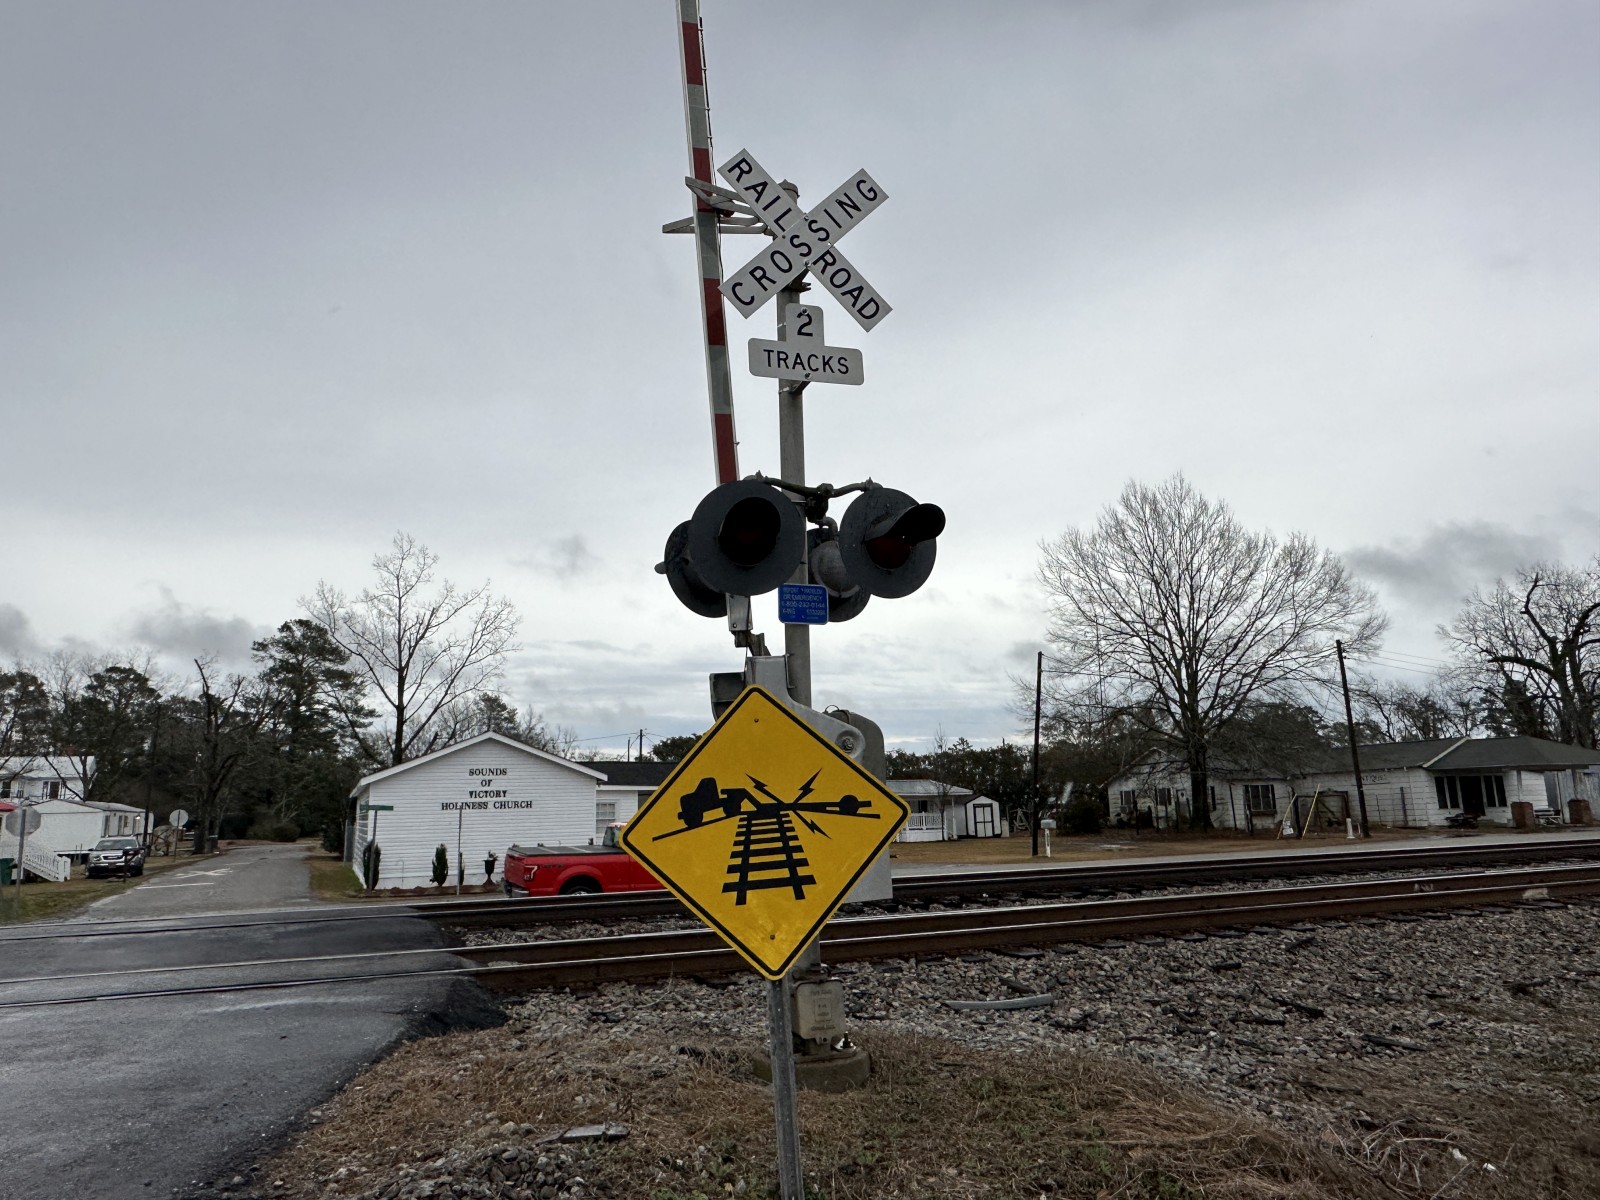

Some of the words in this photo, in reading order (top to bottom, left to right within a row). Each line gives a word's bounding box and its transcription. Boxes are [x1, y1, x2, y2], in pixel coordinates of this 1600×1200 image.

[727, 157, 792, 232] RAIL
[811, 249, 880, 320] ROAD
[731, 179, 878, 306] CROSSING
[797, 312, 813, 337] 2
[763, 349, 849, 375] TRACKS
[468, 768, 508, 776] SOUNDS
[481, 779, 492, 787] OF
[468, 790, 508, 798] VICTORY
[441, 802, 488, 810] HOLINESS
[493, 801, 532, 809] CHURCH
